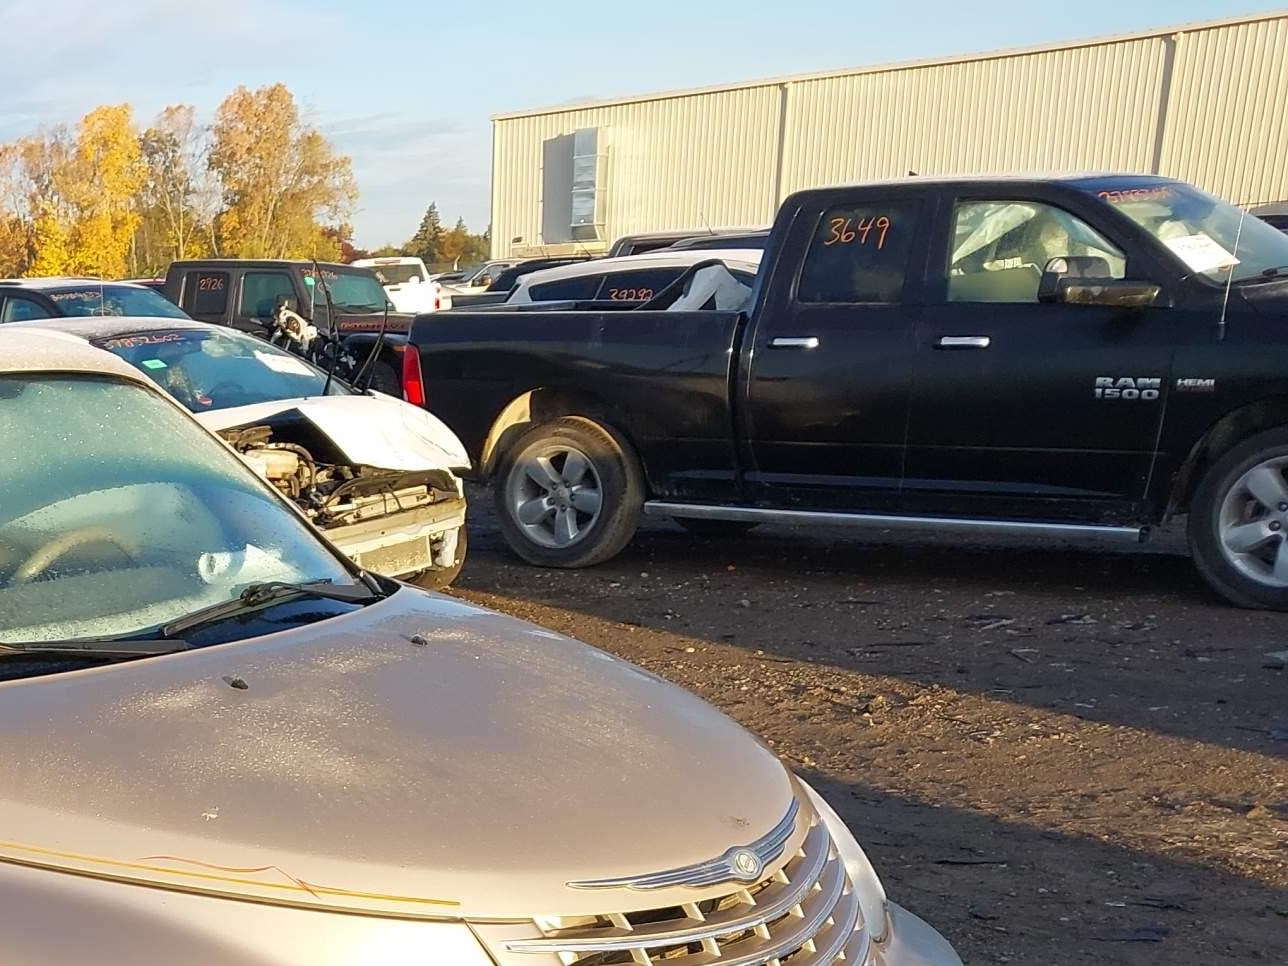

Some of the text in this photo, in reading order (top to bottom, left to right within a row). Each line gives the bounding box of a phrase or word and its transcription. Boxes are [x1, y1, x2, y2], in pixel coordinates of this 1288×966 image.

[824, 216, 890, 250] 3649
[198, 277, 225, 290] 2926
[1095, 376, 1215, 388] RAM HEMI
[1095, 388, 1160, 400] 1500
